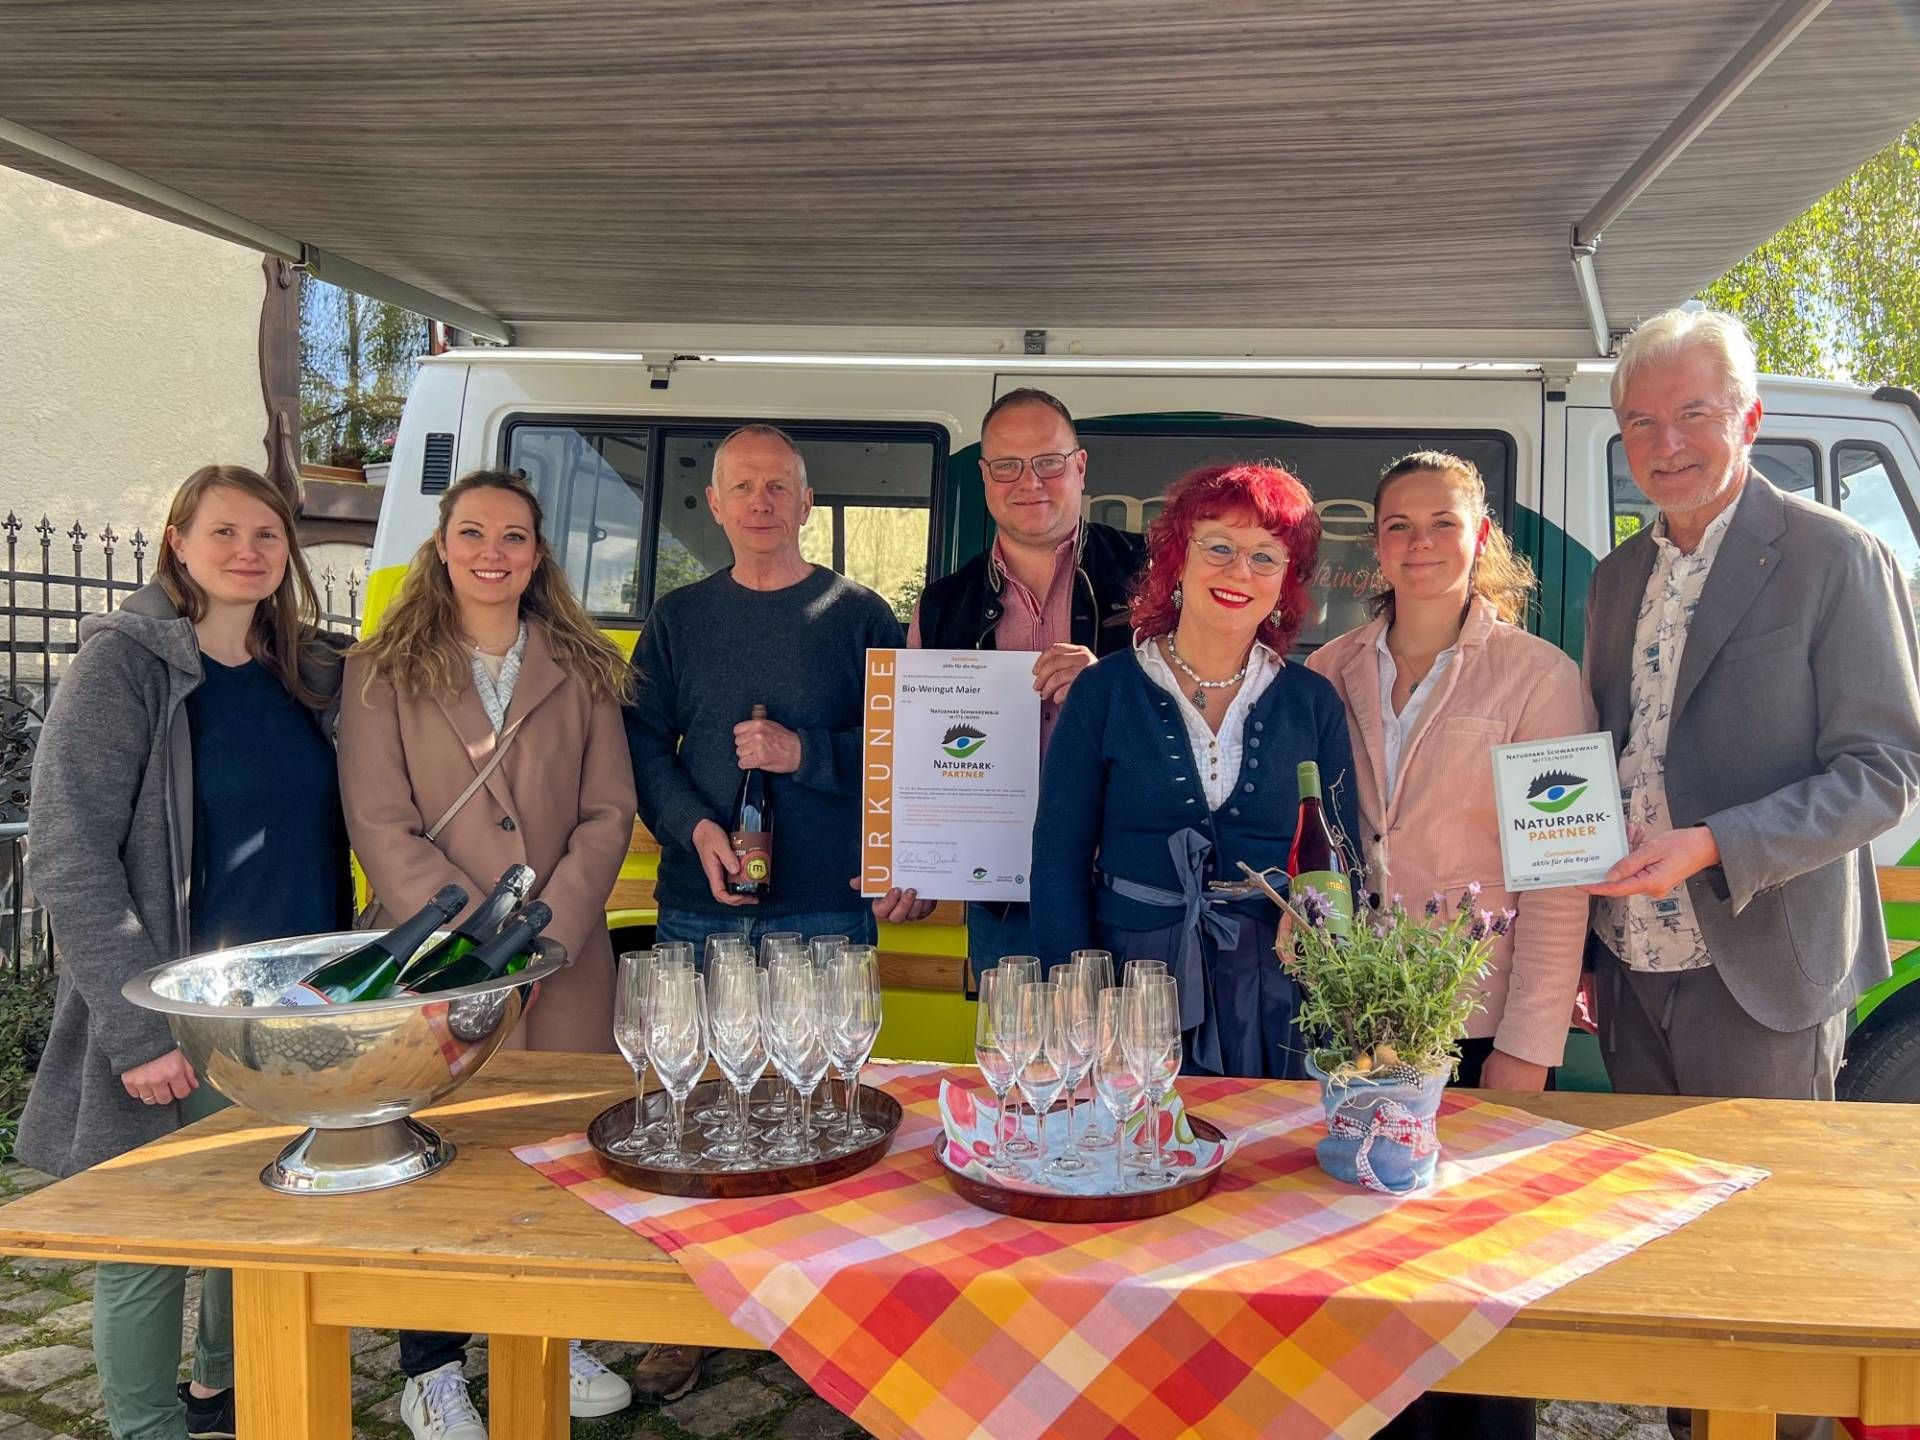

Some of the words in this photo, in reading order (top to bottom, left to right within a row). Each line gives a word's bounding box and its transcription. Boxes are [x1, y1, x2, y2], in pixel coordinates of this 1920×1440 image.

[902, 684, 954, 695] Bio-Weingut
[956, 685, 981, 694] Maier
[933, 759, 995, 770] NATURPARK-
[867, 661, 894, 882] URKUNDE
[942, 770, 984, 779] PARTNER
[1513, 812, 1611, 831] NATURPARK-
[1529, 825, 1598, 842] PARTNER
[1563, 856, 1574, 864] die
[1576, 854, 1600, 864] Region
